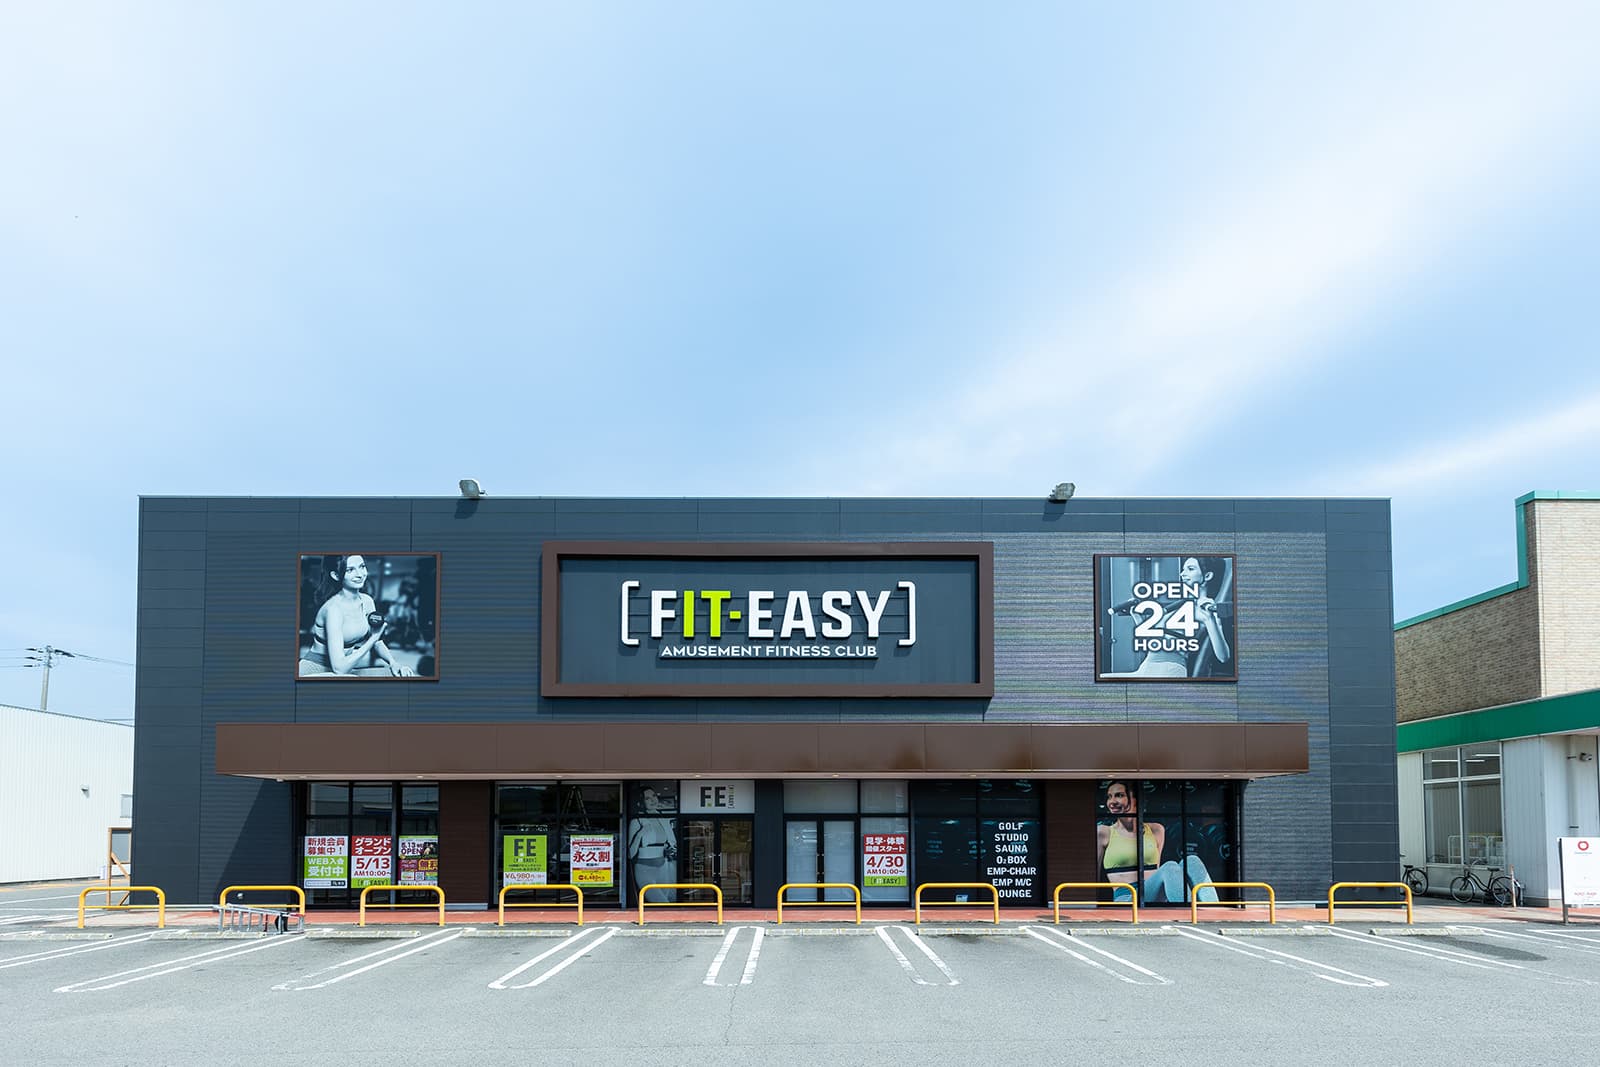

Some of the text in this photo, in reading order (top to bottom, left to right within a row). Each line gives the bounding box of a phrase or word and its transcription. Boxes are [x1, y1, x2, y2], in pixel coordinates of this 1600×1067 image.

[1133, 582, 1199, 599] OPEN
[1134, 601, 1199, 637] 24
[1134, 639, 1199, 652] HOURS
[661, 645, 877, 657] AMUSEMENT FITNESS CLUB
[998, 822, 1025, 830] GOLF
[307, 837, 345, 847] 新規会員
[355, 837, 392, 846] グランド
[994, 833, 1029, 842] STUDIO
[355, 846, 392, 855] オープン
[994, 844, 1029, 853] SAUNA
[572, 851, 611, 862] 永久割
[866, 855, 904, 868] 4/30
[356, 857, 390, 870] 5/13
[308, 866, 344, 877] 受付中
[987, 867, 1037, 876] EMP-CHAIR
[992, 878, 1032, 887] EMP M/C
[999, 889, 1032, 898] OUNGE
